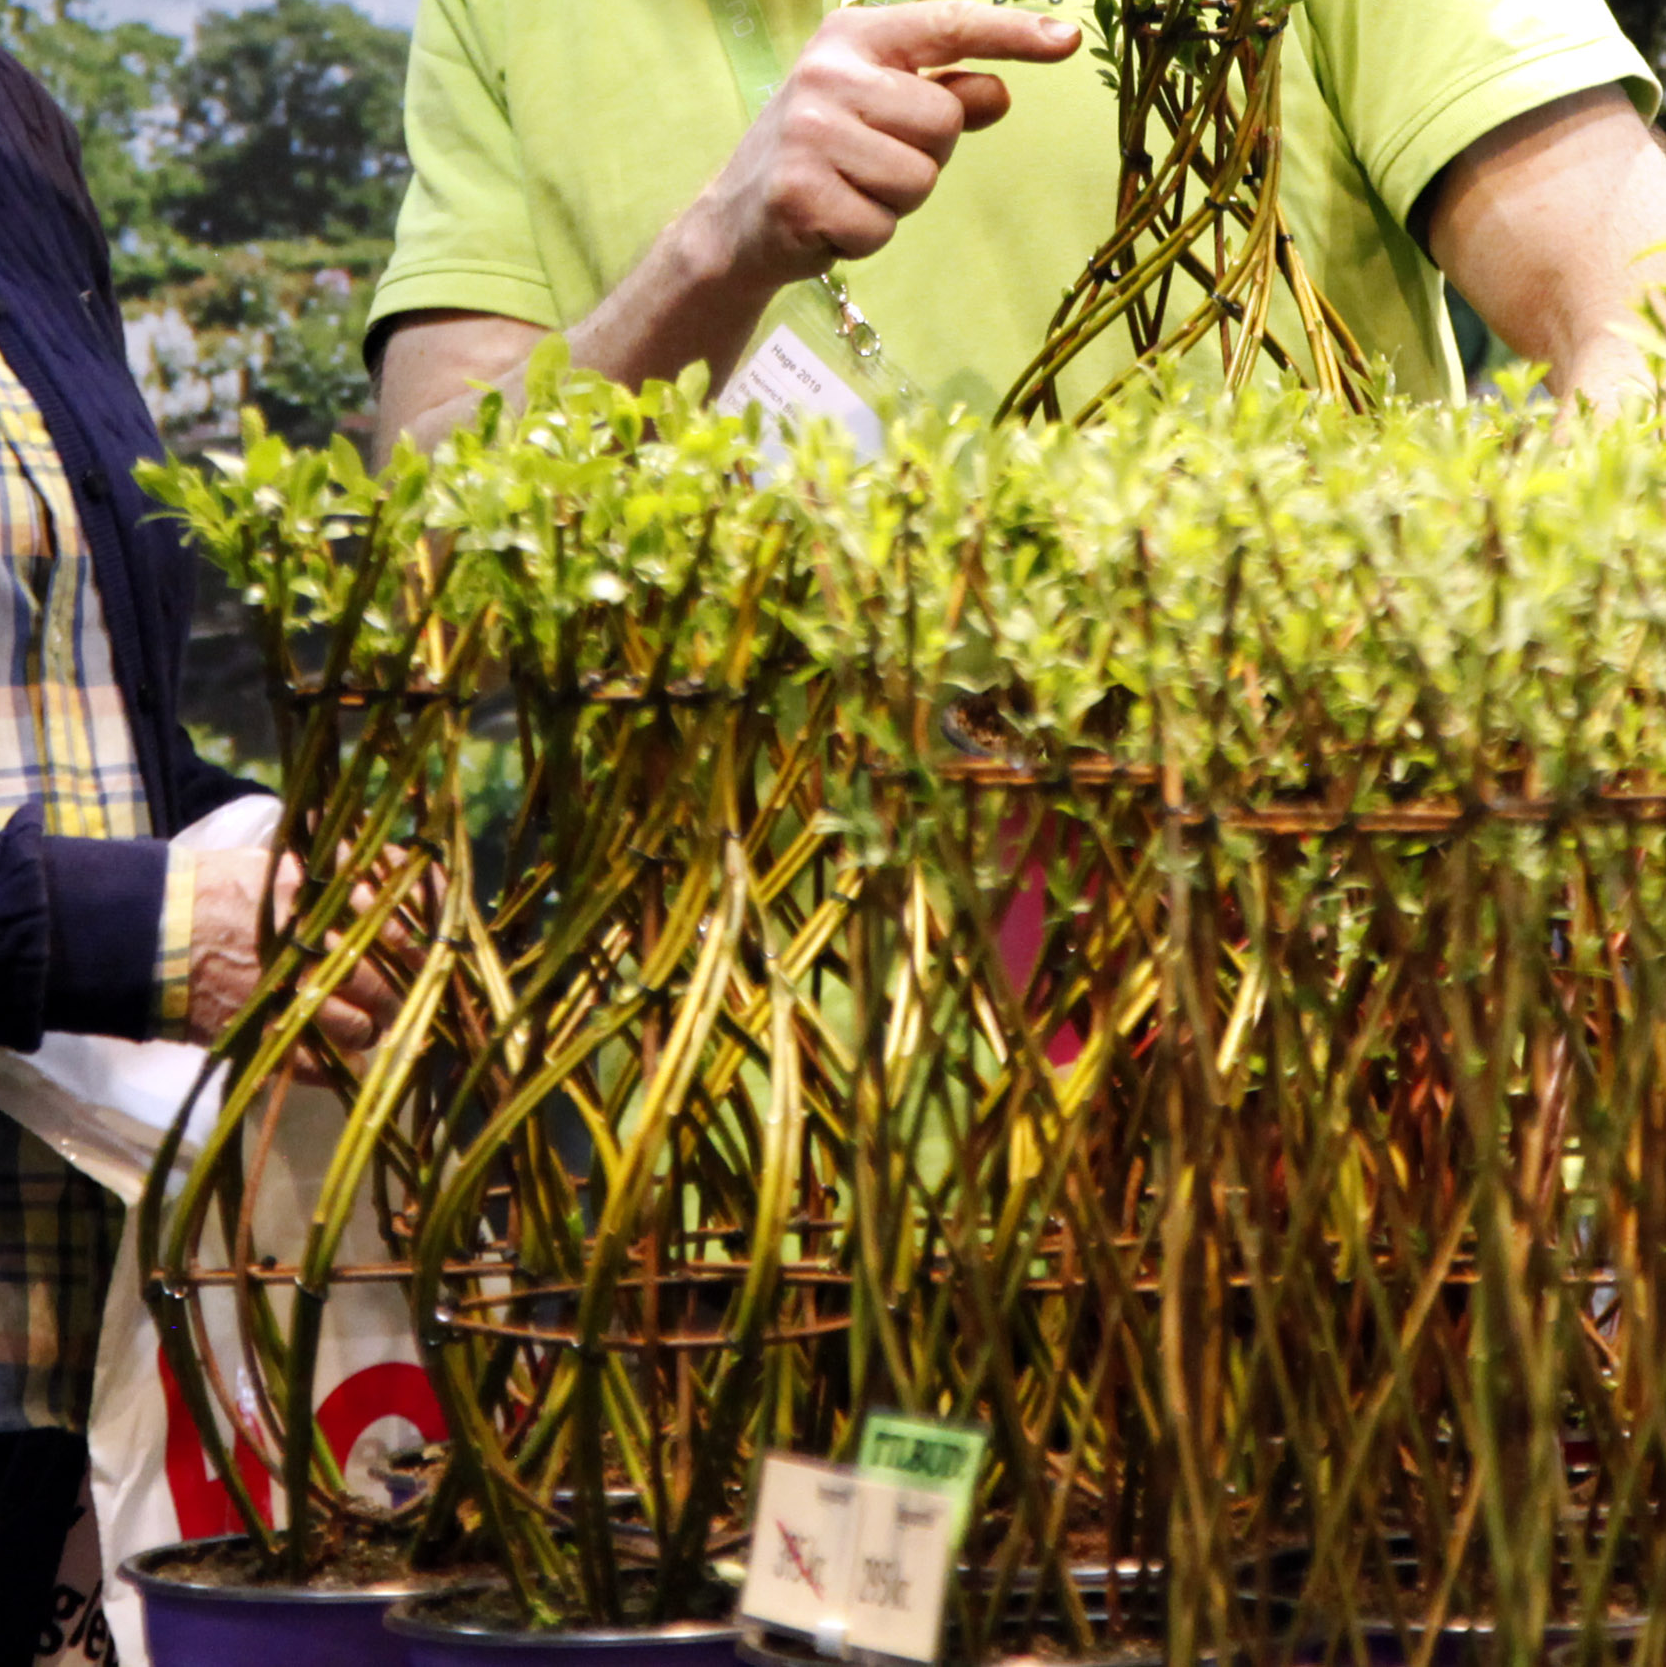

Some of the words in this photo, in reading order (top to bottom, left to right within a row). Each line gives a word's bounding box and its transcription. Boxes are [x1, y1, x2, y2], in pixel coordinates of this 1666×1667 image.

[749, 370, 784, 405] Heinrich
[770, 343, 797, 371] Hage
[796, 369, 822, 394] 2019
